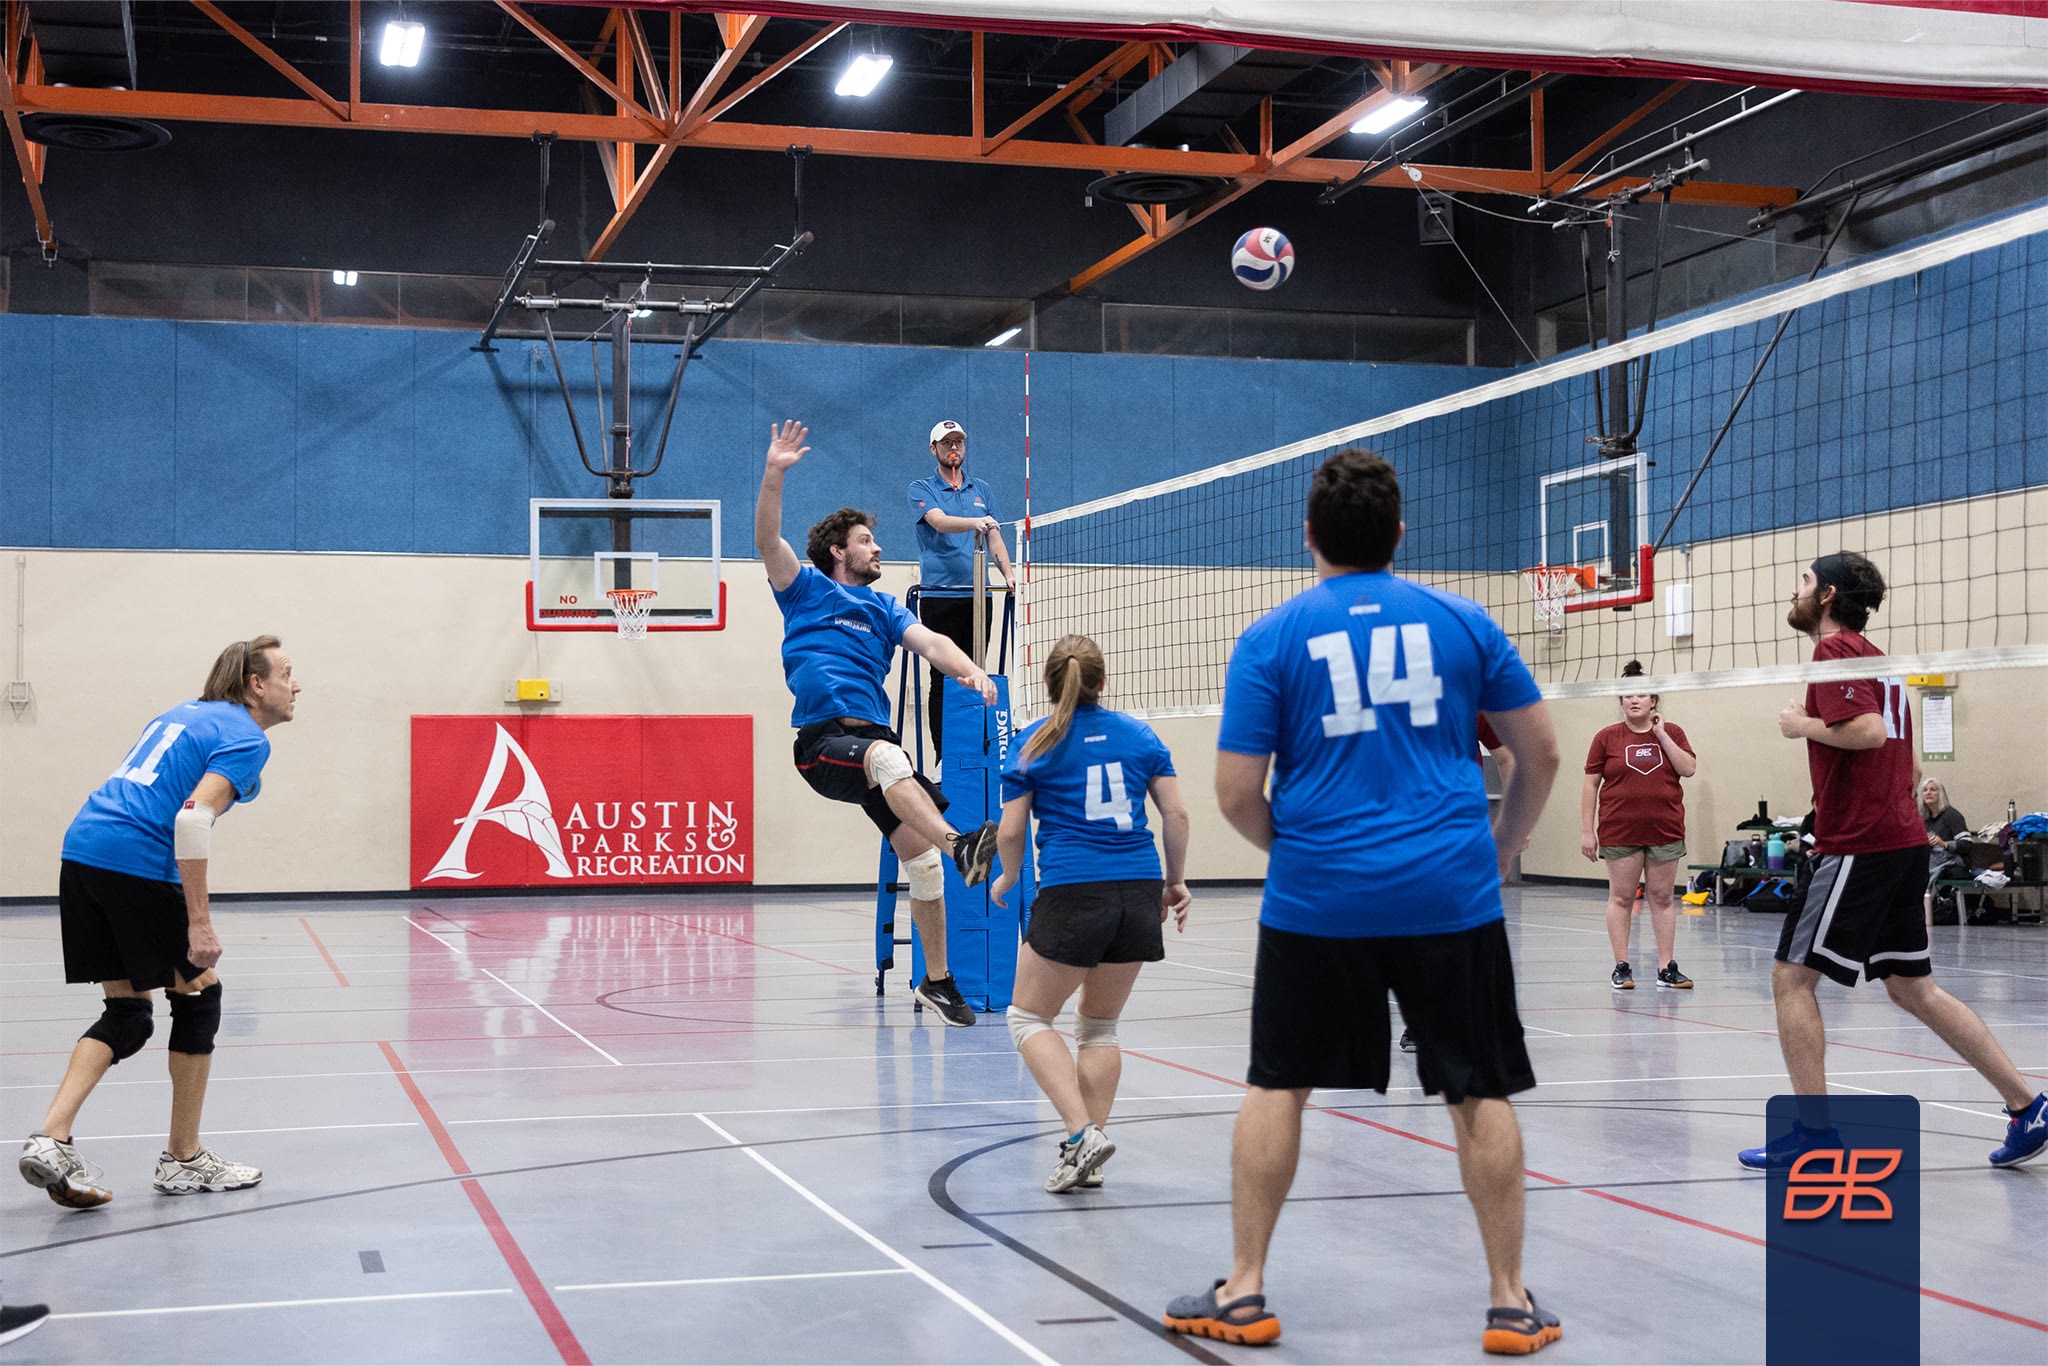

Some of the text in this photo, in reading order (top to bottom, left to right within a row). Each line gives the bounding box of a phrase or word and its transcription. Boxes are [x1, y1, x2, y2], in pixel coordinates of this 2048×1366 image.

[539, 609, 599, 619] DUNKING
[559, 595, 578, 604] NO
[1306, 622, 1443, 738] 14
[107, 720, 187, 787] 11
[1084, 761, 1133, 831] 4
[563, 801, 734, 830] AUSTIN
[571, 817, 738, 853] PARKS &
[576, 853, 746, 877] RECREATION
